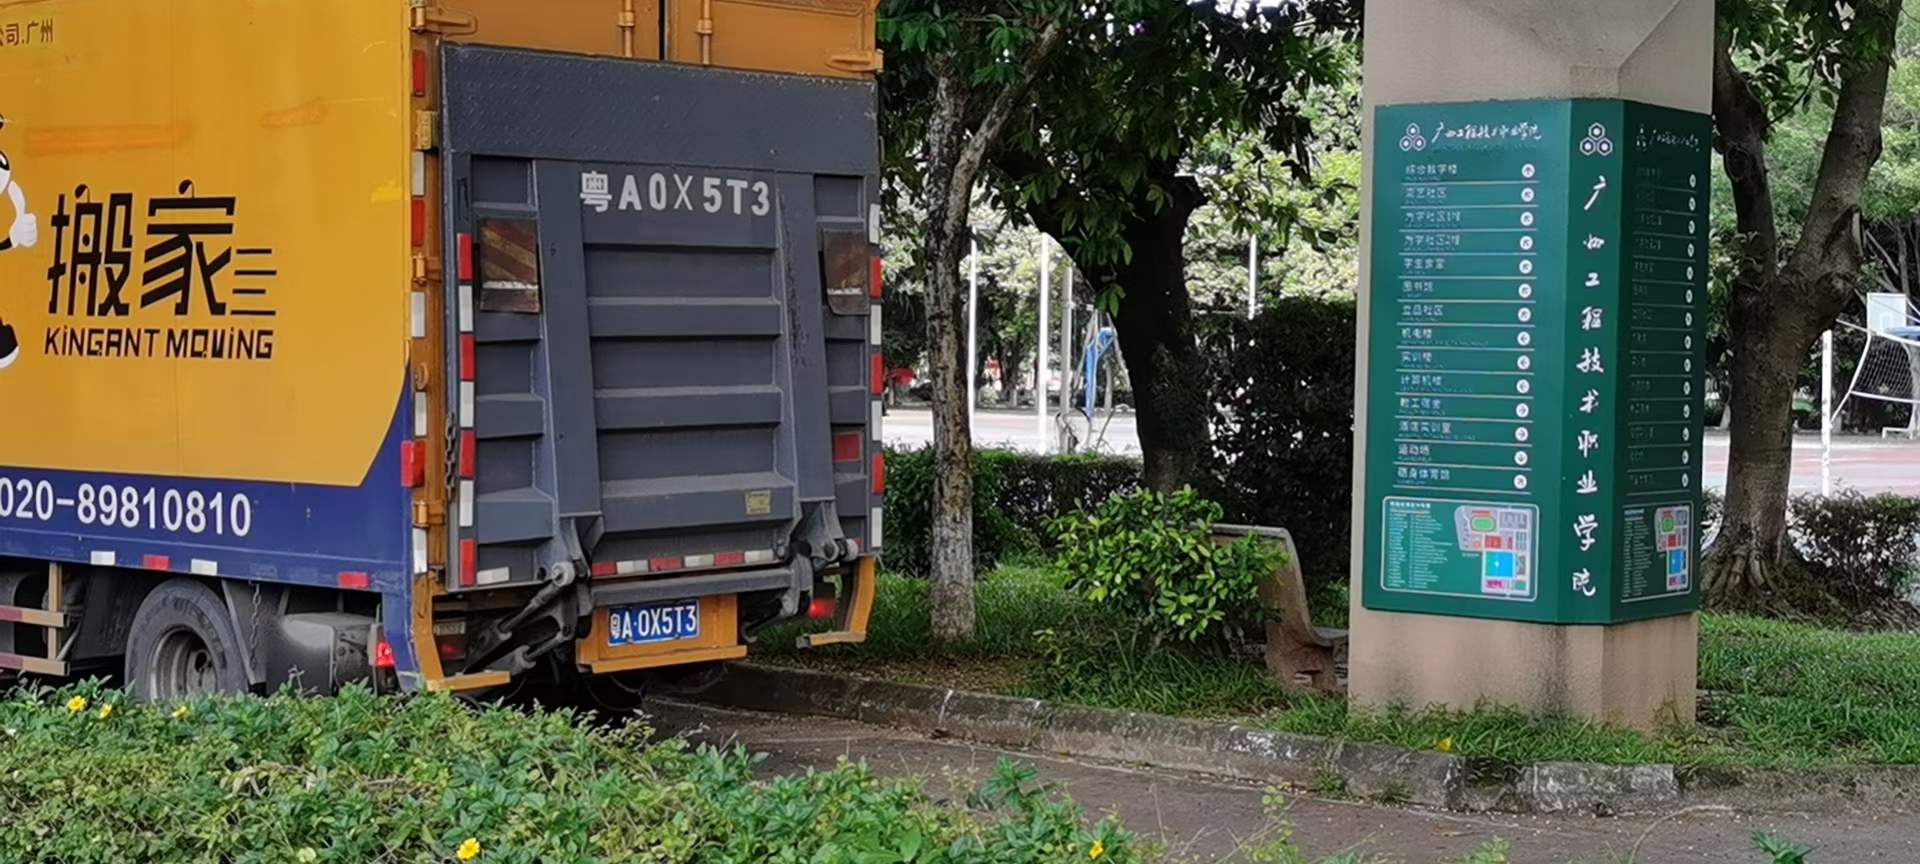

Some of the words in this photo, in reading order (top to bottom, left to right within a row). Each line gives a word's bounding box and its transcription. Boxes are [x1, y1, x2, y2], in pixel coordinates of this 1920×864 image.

[580, 170, 770, 216] 粤A0X5T3
[47, 179, 236, 316] 搬家
[1400, 374, 1442, 386] 计算机楼
[1572, 175, 1607, 597] 广州工程技术职业学院
[0, 477, 252, 537] 020-89810810
